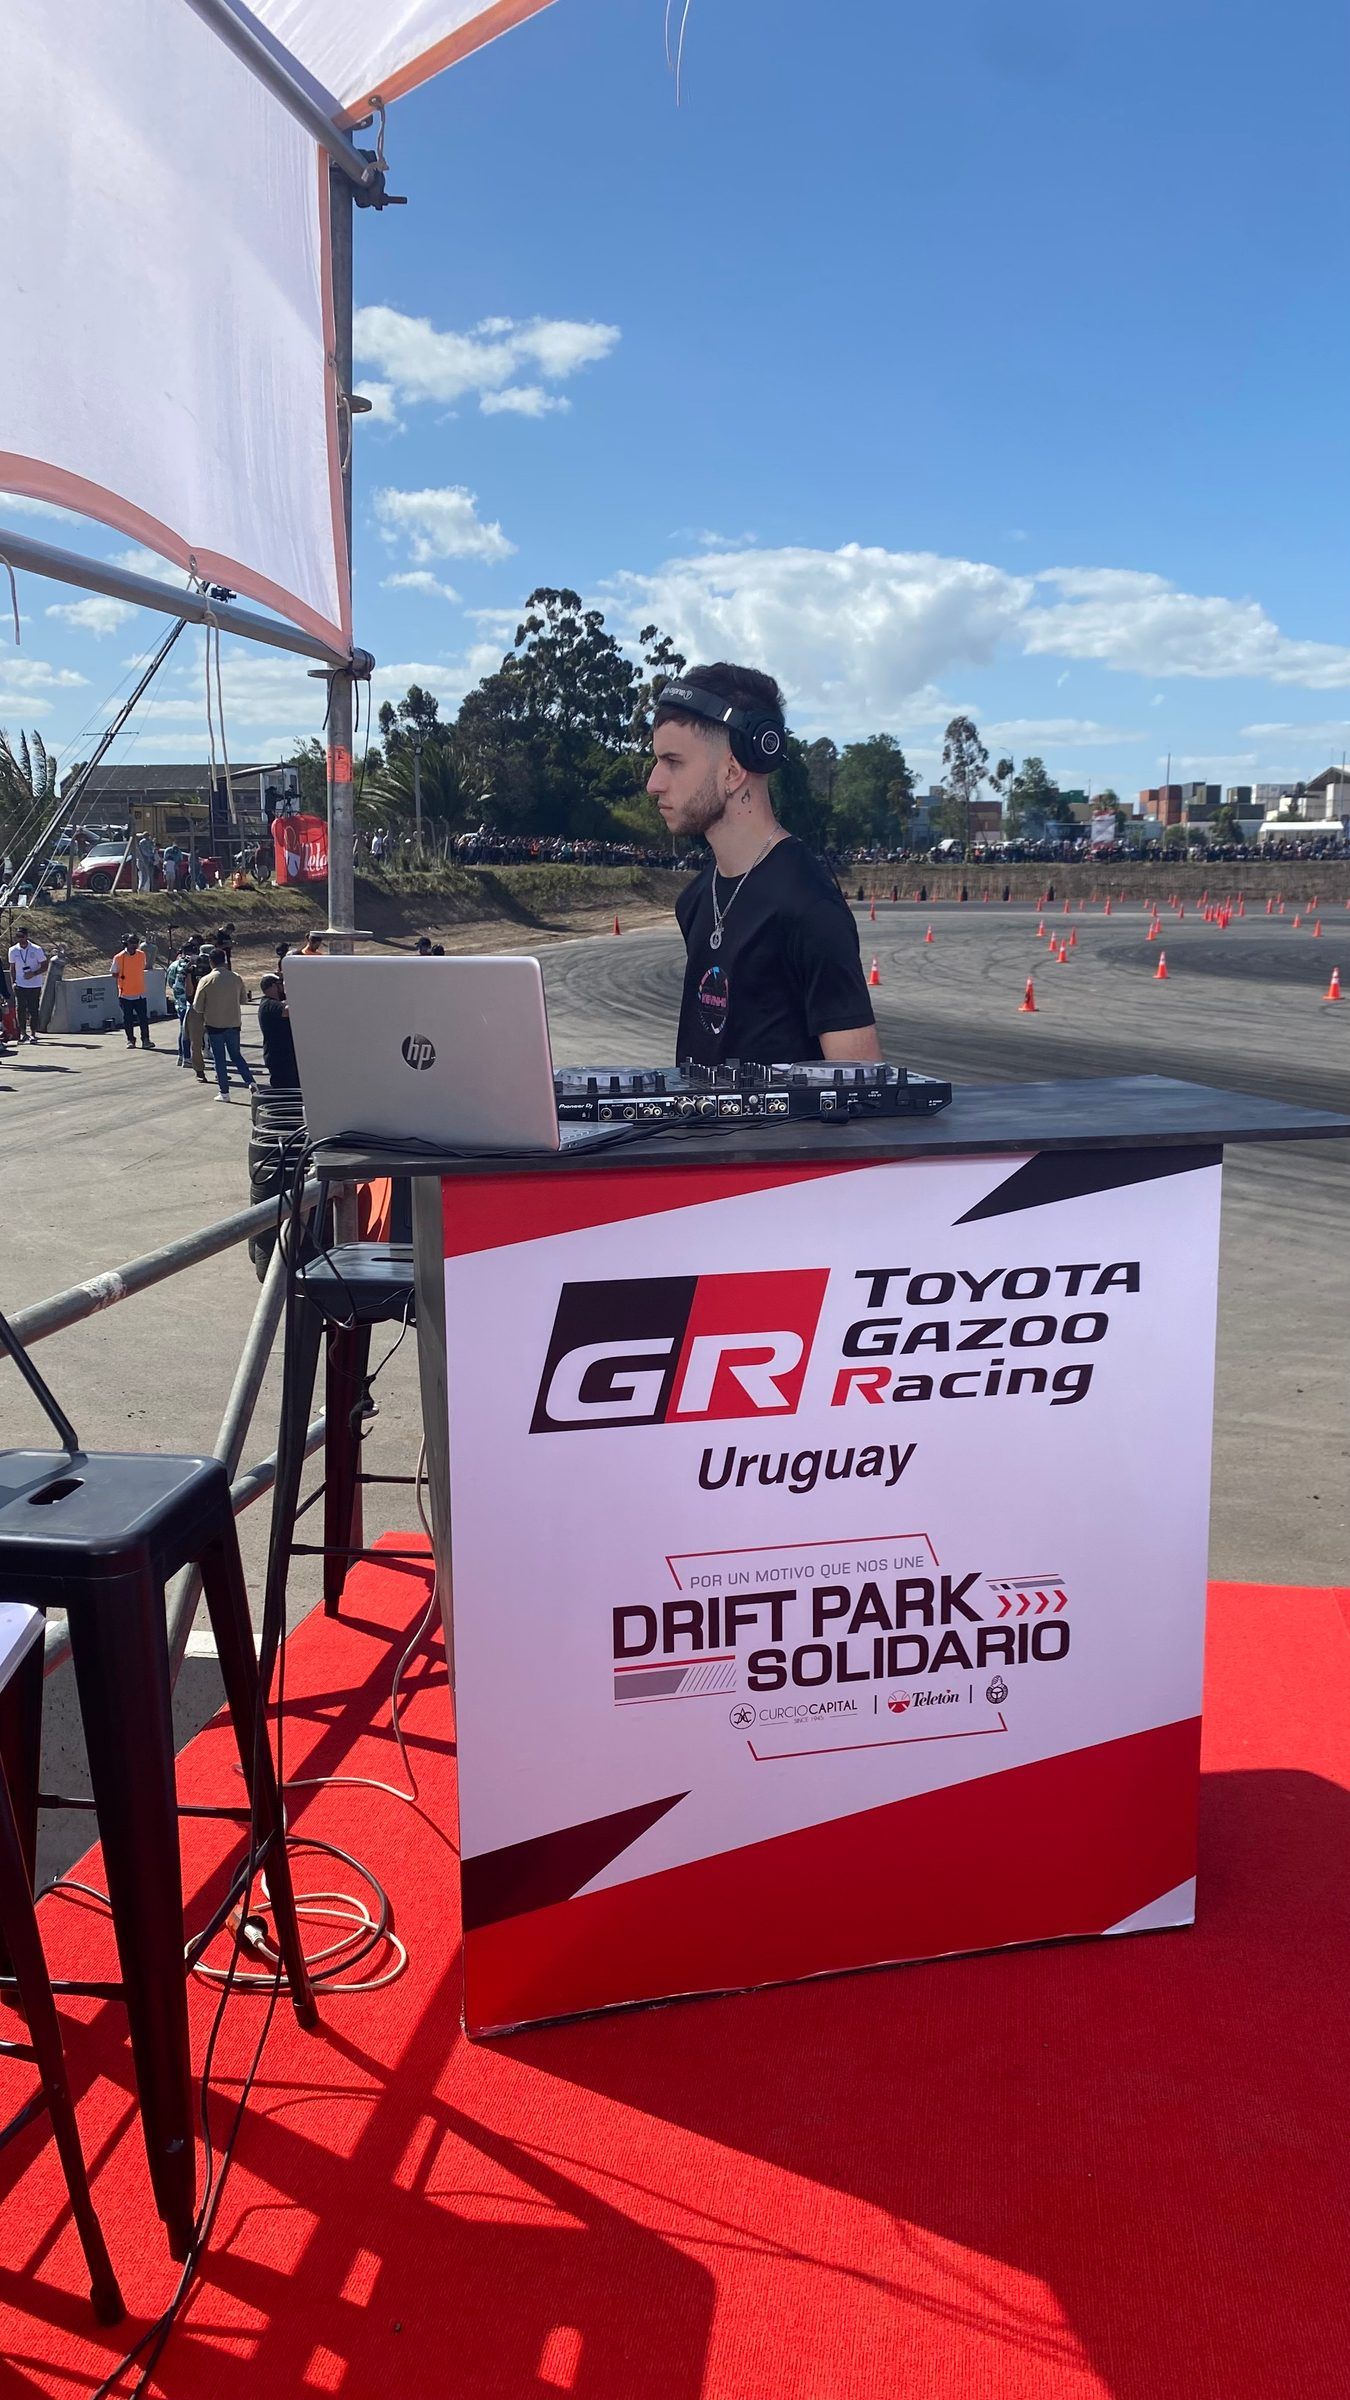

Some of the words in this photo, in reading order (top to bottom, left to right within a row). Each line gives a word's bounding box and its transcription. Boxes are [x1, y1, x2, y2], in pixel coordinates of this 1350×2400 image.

[406, 1034, 432, 1070] hp
[853, 1262, 1140, 1308] TOYOTA
[841, 1312, 1109, 1357] GAZOO
[546, 1330, 804, 1422] GR
[831, 1358, 1094, 1406] Racing
[698, 1443, 917, 1494] Uruguay
[690, 1574, 722, 1589] POR
[728, 1572, 750, 1585] UN
[756, 1566, 815, 1582] MOTIVO
[821, 1563, 851, 1578] QUE
[856, 1559, 888, 1573] NOS
[894, 1556, 924, 1569] UNE
[612, 1590, 796, 1660] DRIFT
[812, 1572, 984, 1638] PARK
[747, 1620, 1070, 1692] SOLIDARIO
